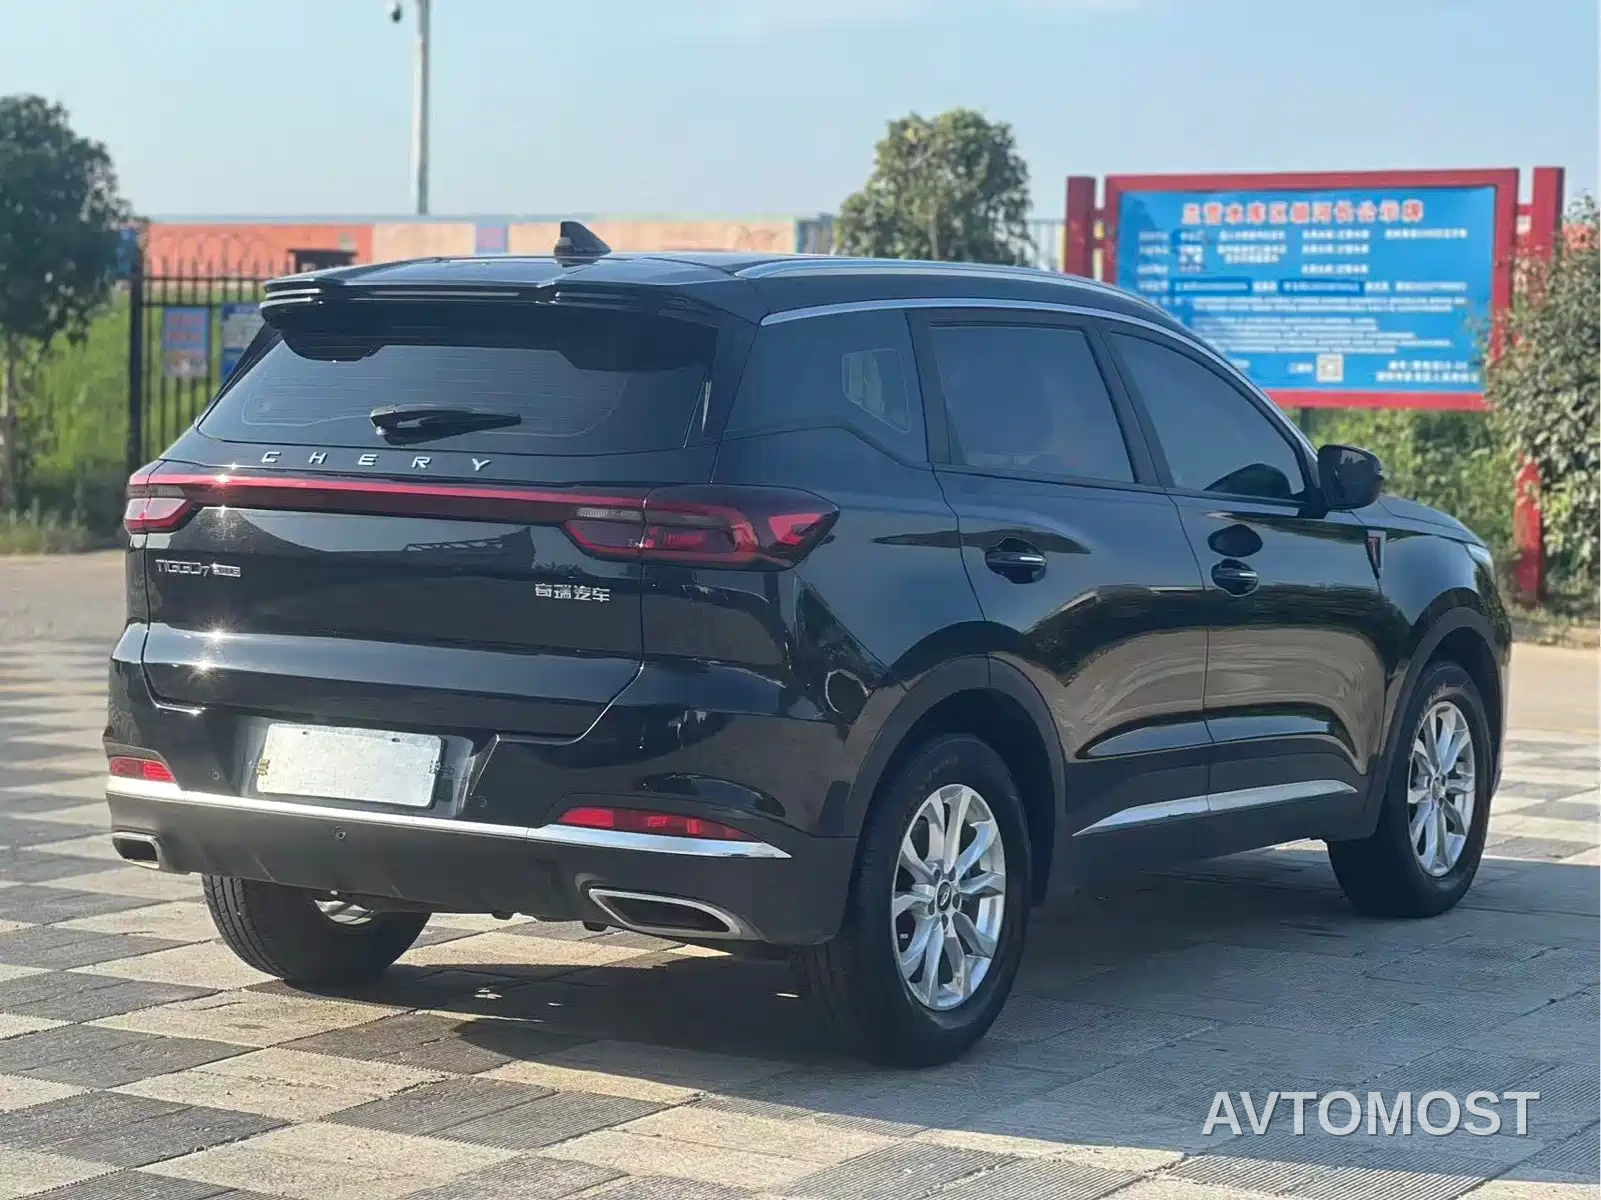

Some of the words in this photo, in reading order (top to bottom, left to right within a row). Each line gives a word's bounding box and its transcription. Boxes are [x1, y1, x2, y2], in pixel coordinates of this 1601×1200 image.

[260, 451, 491, 472] CHERY
[534, 583, 611, 602] 奇瑞汽车
